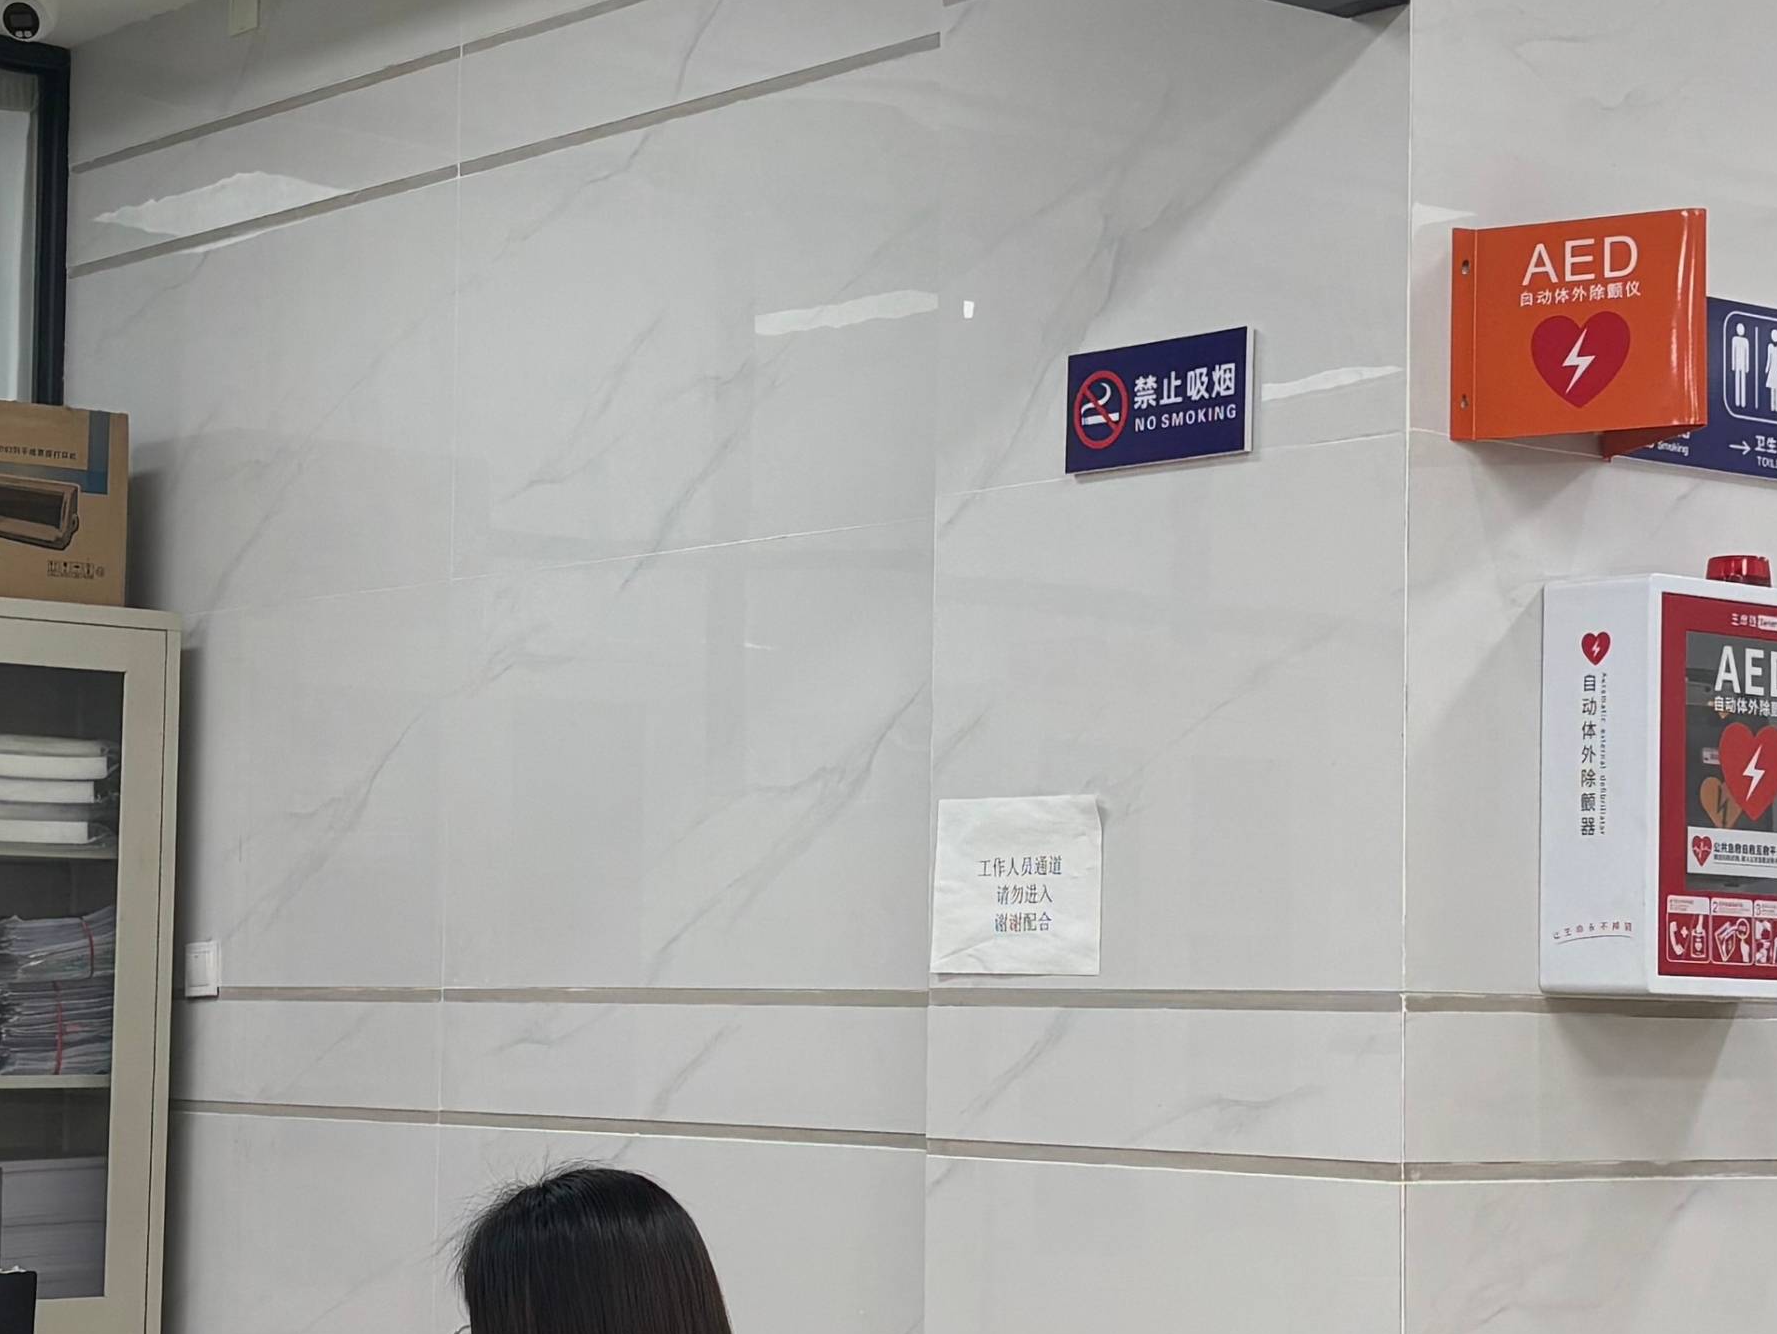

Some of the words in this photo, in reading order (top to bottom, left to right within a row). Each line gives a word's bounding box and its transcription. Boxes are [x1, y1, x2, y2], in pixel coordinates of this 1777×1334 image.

[1522, 235, 1638, 286] AED
[1520, 280, 1642, 307] 自动体外除颤仪
[1134, 363, 1236, 410] 禁止吸烟
[1134, 416, 1157, 433] NO
[1161, 404, 1237, 428] SMOKING
[1581, 674, 1597, 836] 自动体外除颤器
[978, 855, 1062, 877] 工作人员通道
[996, 884, 1053, 905] 请勿进入
[994, 911, 1053, 933] 谢谢配合
